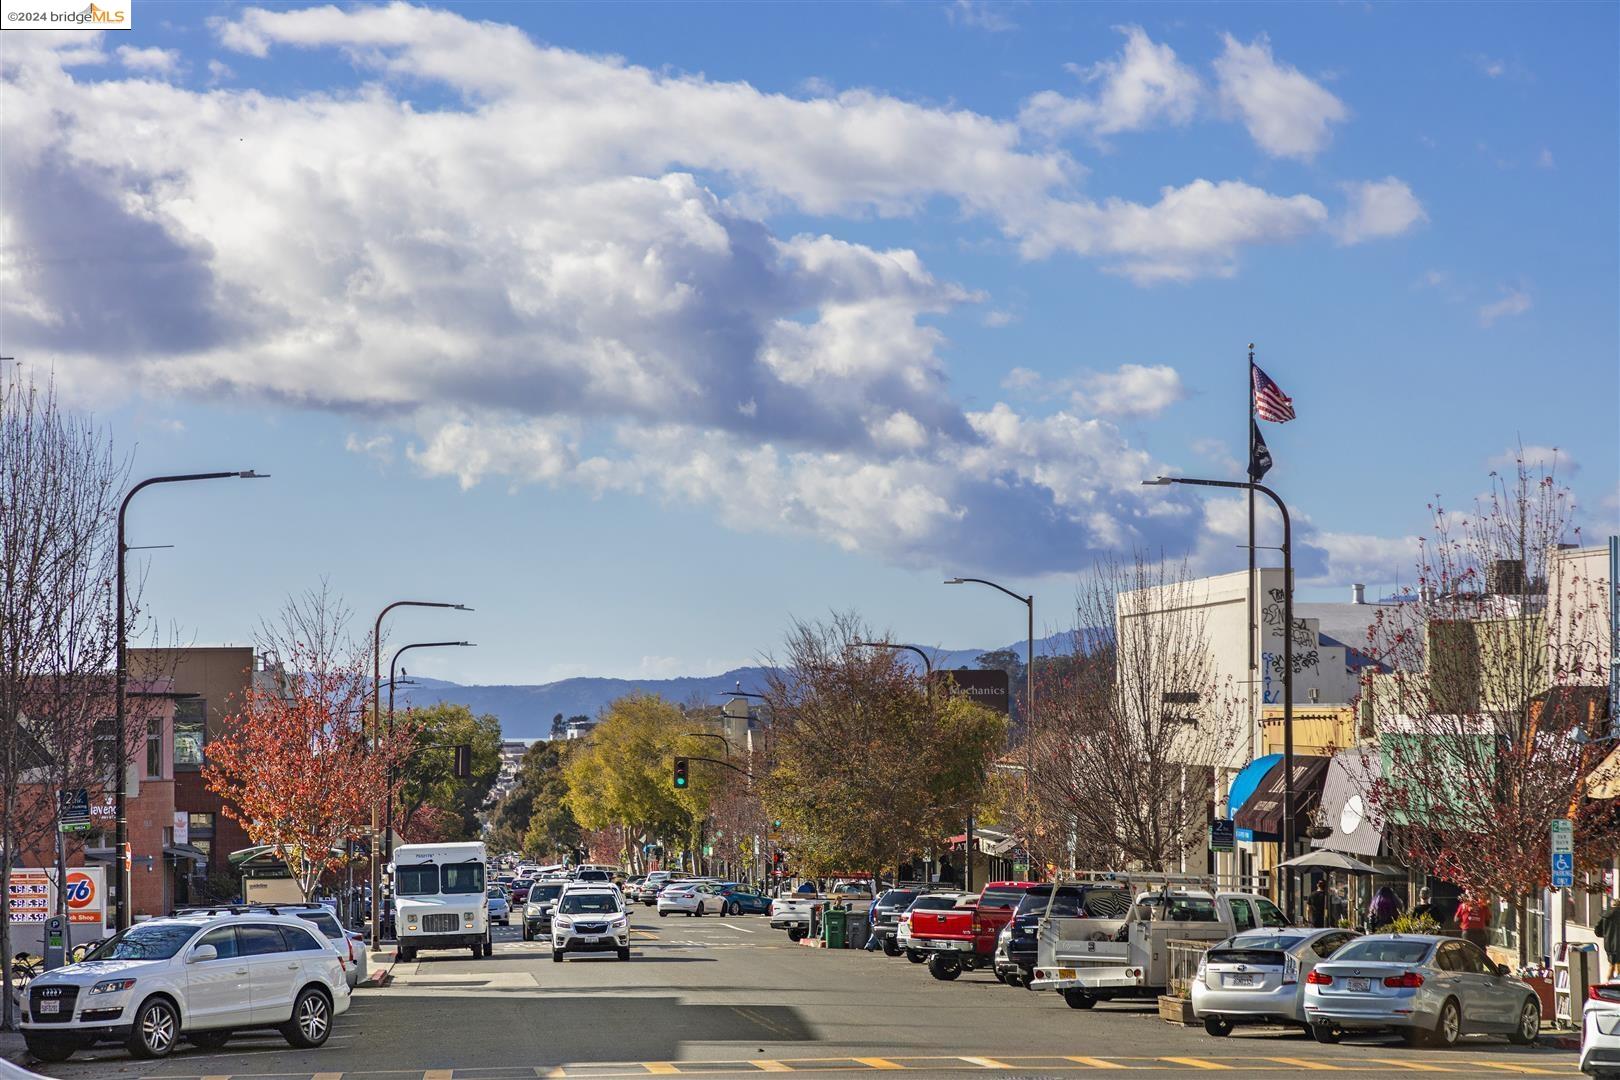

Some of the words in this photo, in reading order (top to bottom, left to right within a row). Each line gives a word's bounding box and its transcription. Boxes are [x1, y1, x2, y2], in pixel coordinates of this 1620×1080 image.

[949, 685, 1005, 695] Mechanics
[65, 791, 73, 805] 2
[1216, 821, 1223, 831] 2
[1553, 821, 1560, 831] 2
[66, 880, 90, 900] 76
